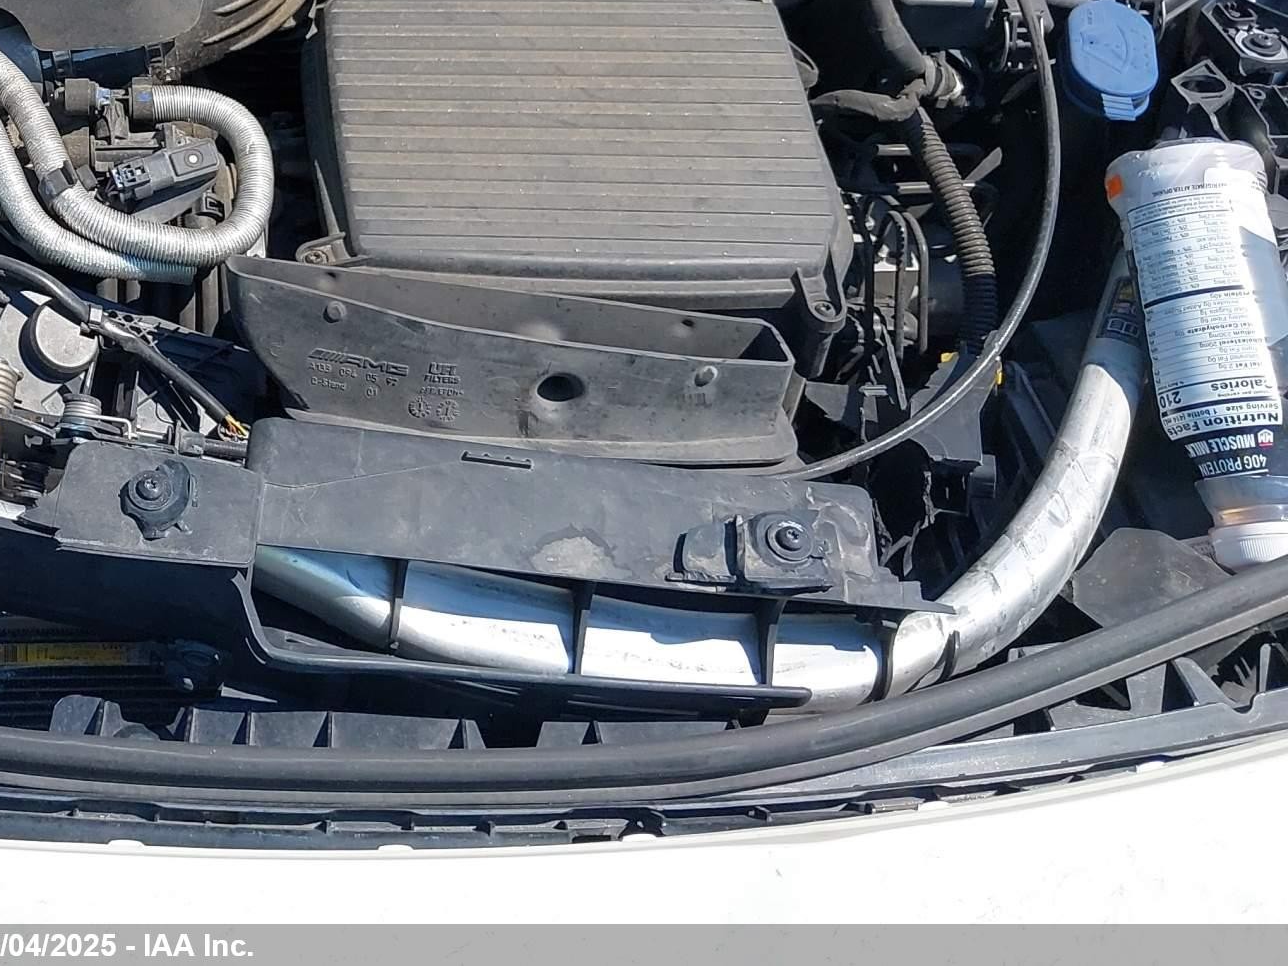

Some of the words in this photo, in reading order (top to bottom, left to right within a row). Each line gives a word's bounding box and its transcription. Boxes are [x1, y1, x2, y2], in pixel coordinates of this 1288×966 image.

[340, 353, 409, 377] AMG
[1158, 390, 1181, 408] 210
[1172, 413, 1185, 423] (414
[1187, 409, 1209, 417] bottle
[1203, 411, 1278, 427] Nutrition
[1166, 421, 1200, 436] Facts
[1184, 440, 1209, 457] MILK
[1207, 433, 1255, 453] MUSCLE
[1198, 456, 1242, 476] PROTEIN
[1243, 453, 1266, 469] 40G
